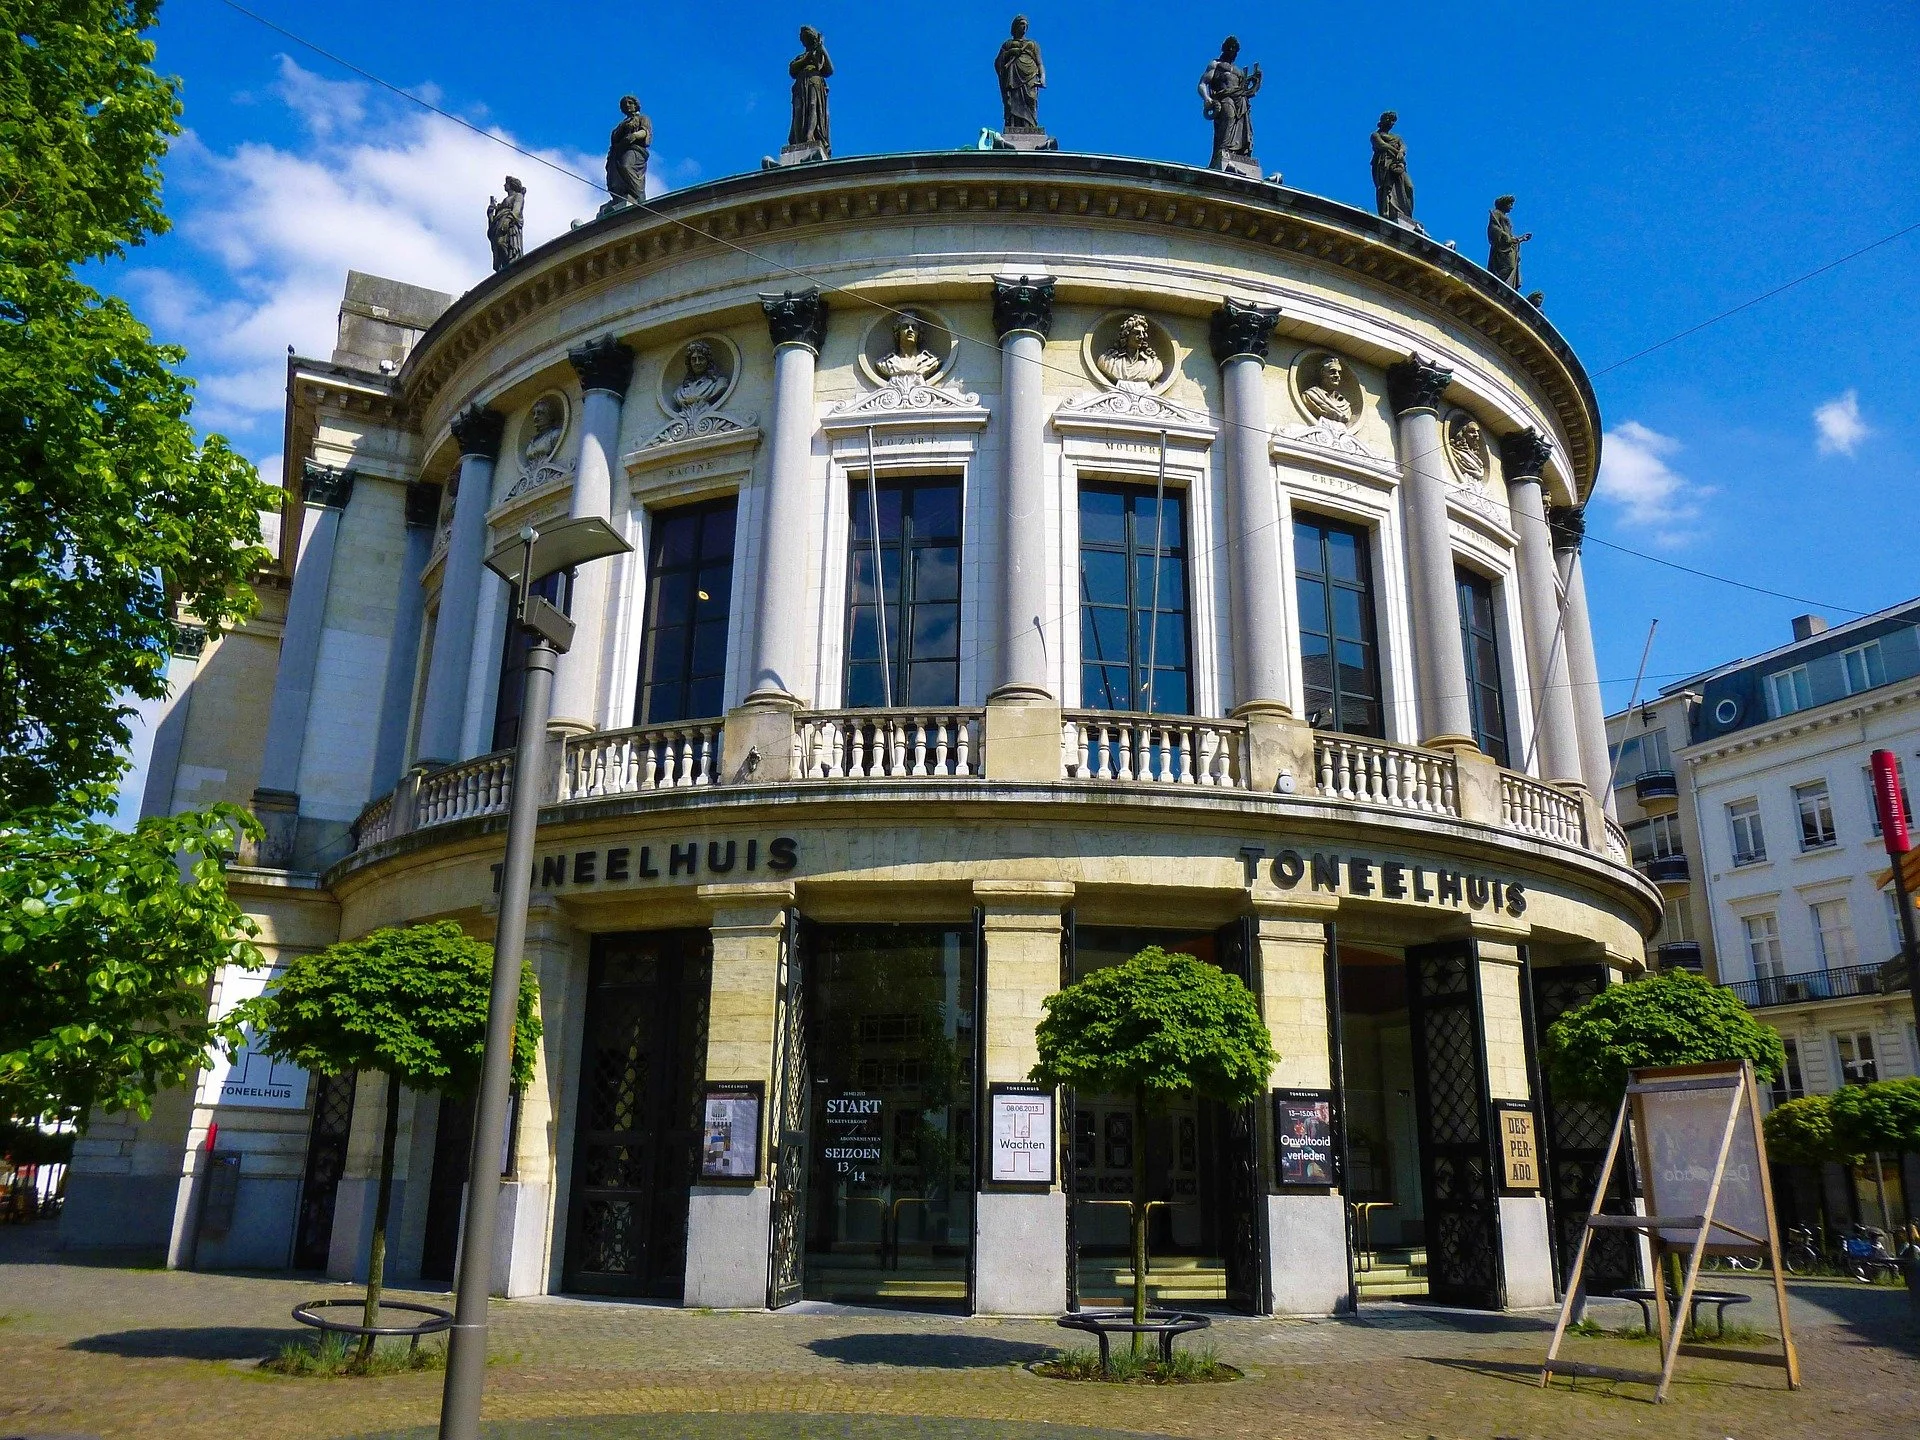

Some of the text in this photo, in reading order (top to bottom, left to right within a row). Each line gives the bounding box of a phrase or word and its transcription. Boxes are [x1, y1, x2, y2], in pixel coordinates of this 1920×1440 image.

[490, 837, 798, 893] TNEELHUIS
[1239, 846, 1528, 918] TONEELHUIS
[220, 1086, 291, 1098] TONEELHUIS
[826, 1099, 882, 1114] START
[1508, 1117, 1530, 1135] DES-
[1000, 1138, 1045, 1150] Wachten
[1280, 1134, 1331, 1147] Onvoltooid
[825, 1148, 881, 1159] SEIZOEN
[1287, 1149, 1326, 1161] verleden
[1510, 1140, 1532, 1158] PER-
[1512, 1163, 1532, 1181] ADO
